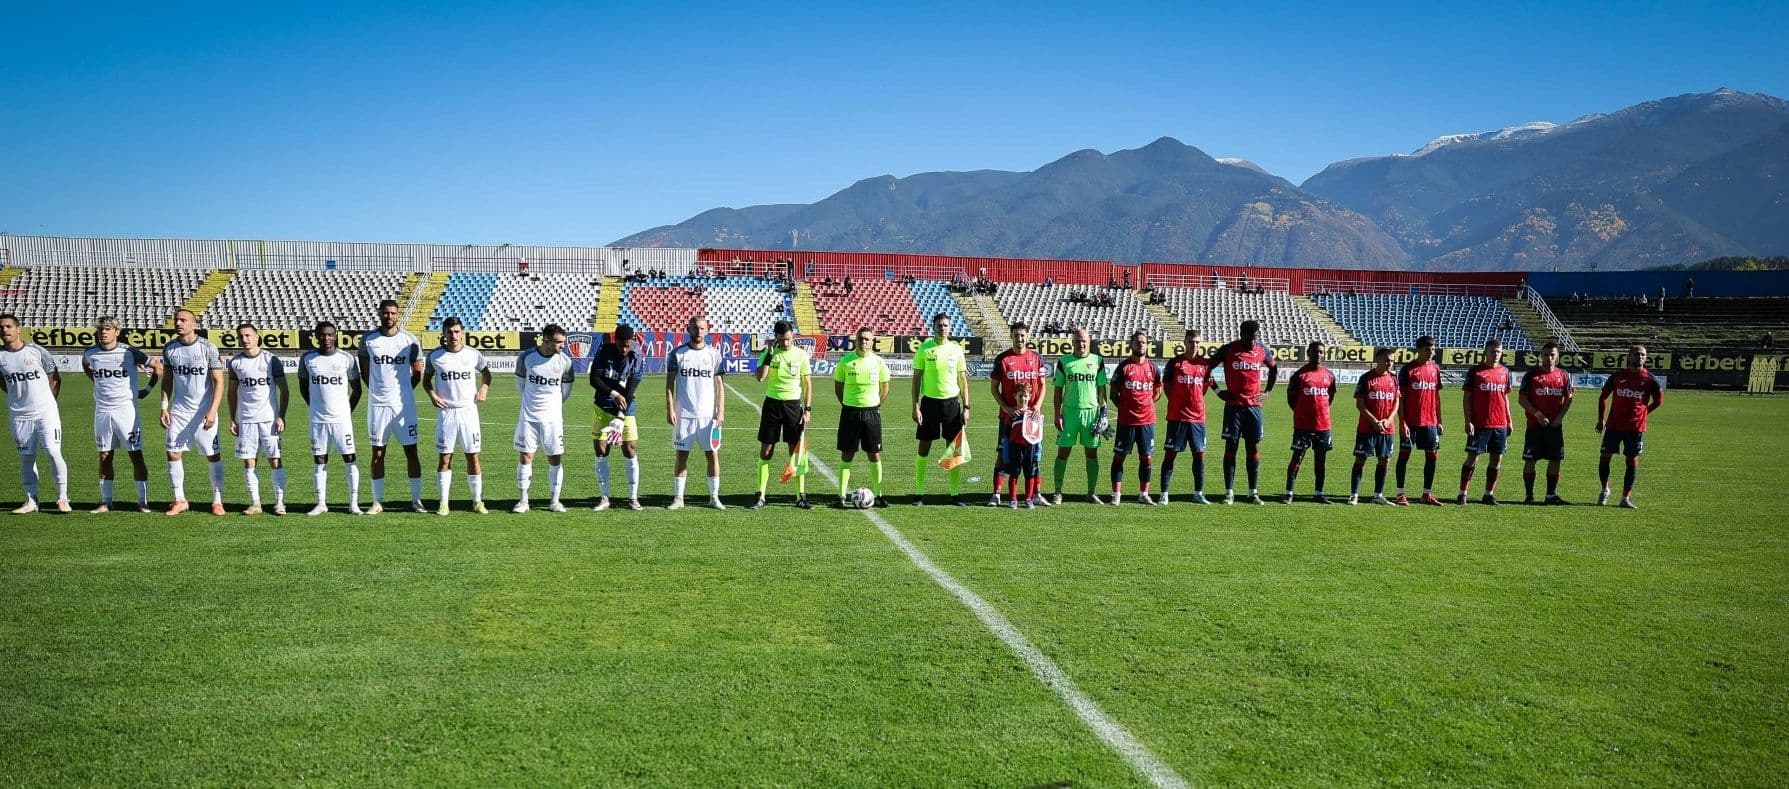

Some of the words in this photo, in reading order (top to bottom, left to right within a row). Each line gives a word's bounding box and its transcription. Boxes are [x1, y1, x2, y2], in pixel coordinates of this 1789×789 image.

[1679, 354, 1746, 371] efbet
[680, 367, 711, 378] efbet
[529, 374, 559, 387] efbet
[345, 433, 353, 446] 2
